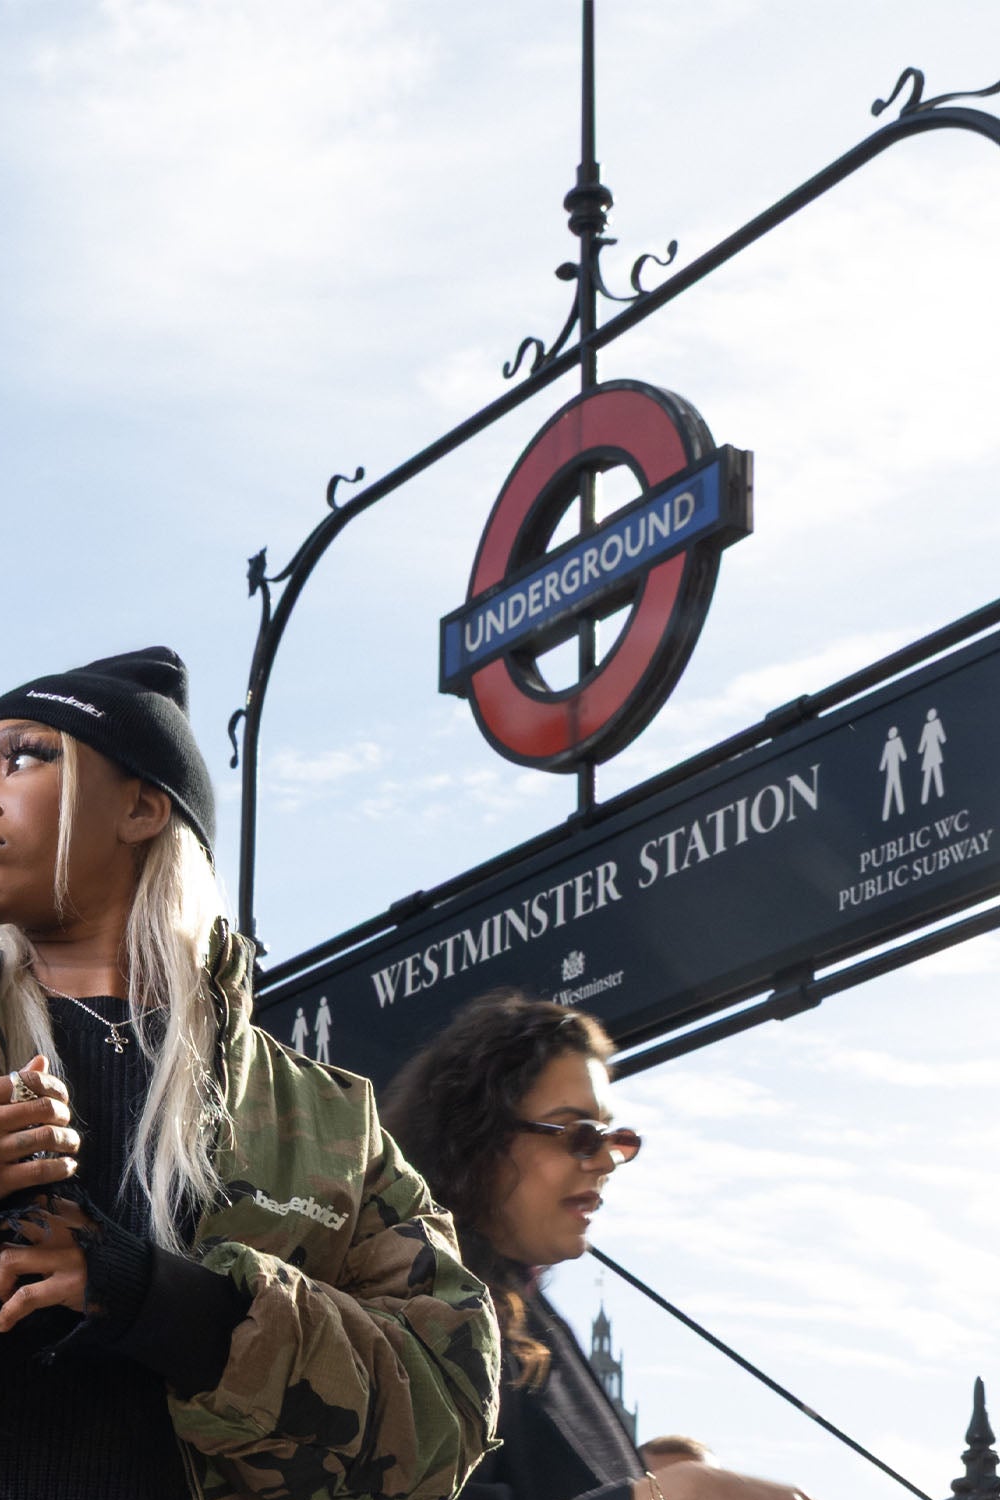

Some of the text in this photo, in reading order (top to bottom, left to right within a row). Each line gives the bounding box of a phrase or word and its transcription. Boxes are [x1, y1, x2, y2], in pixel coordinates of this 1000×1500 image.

[465, 491, 695, 653] UNDERGROUND
[838, 829, 993, 911] PUBLIC SUBWAY
[859, 809, 969, 874] PUBLIC WC
[370, 763, 821, 1009] WESTMINSTER STATION
[560, 970, 624, 1008] Westminster
